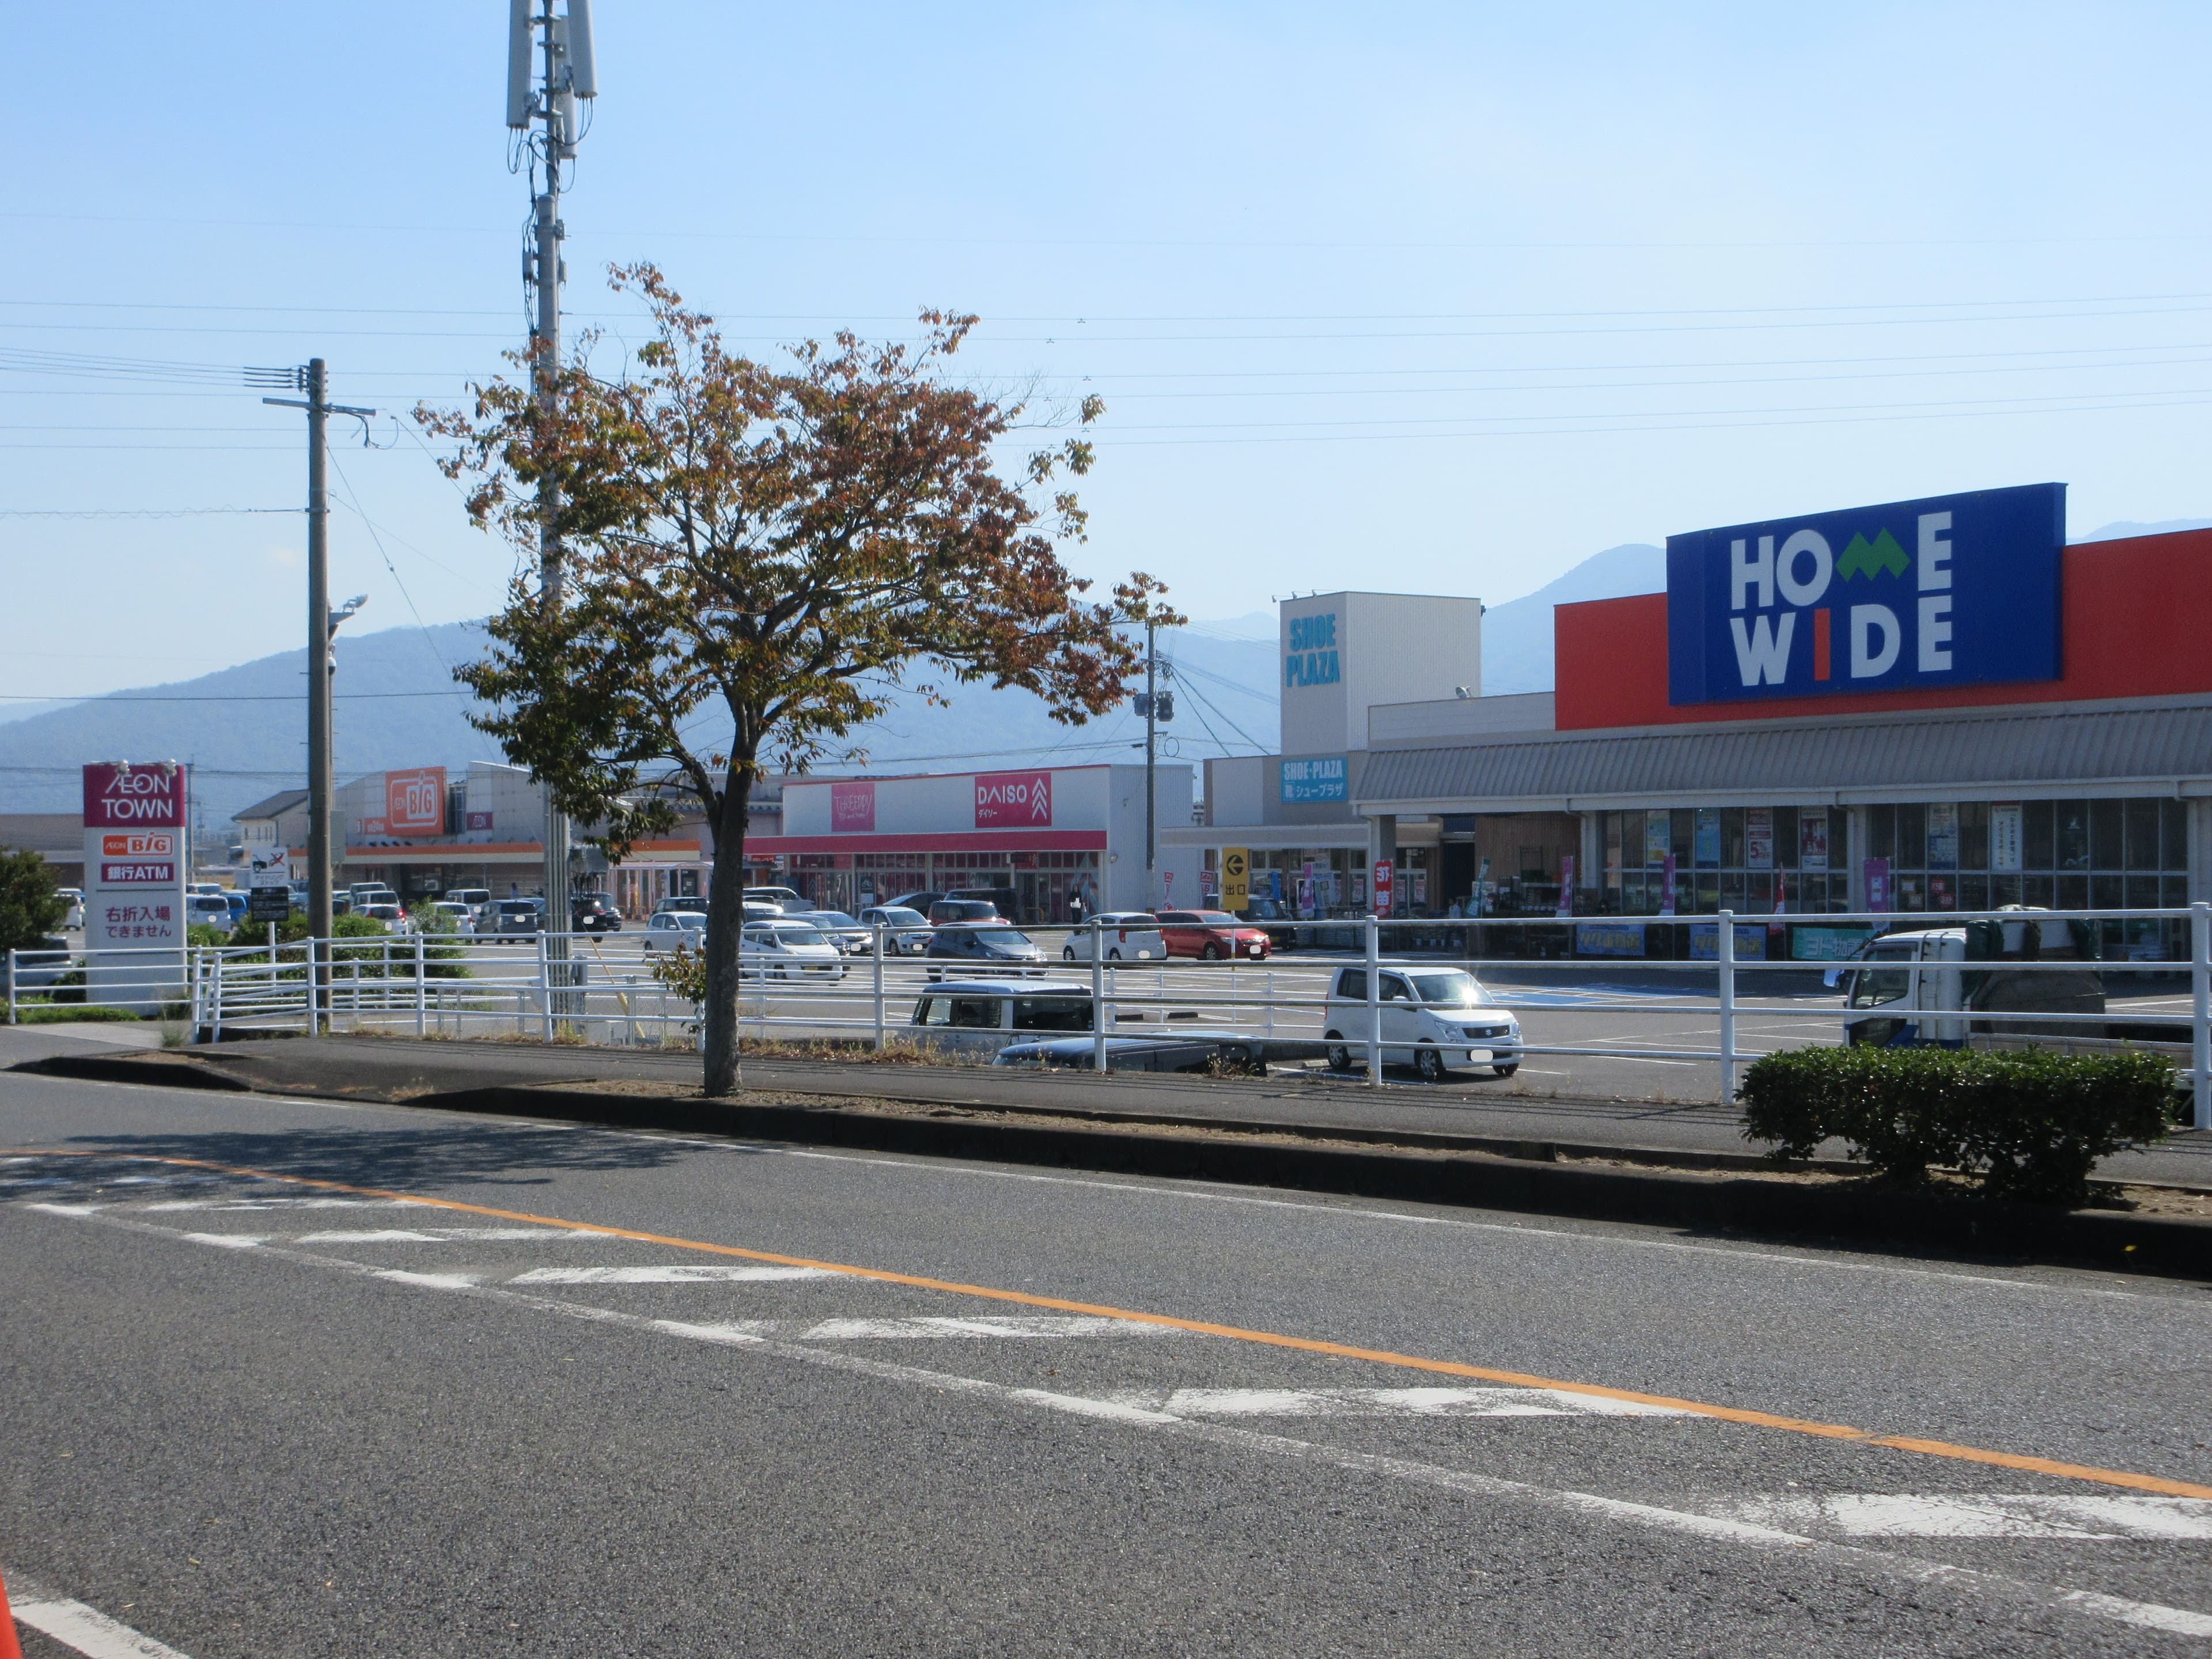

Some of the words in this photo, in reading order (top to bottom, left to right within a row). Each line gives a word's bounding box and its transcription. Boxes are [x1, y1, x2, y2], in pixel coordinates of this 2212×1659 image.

[1730, 511, 1952, 610] HOME
[1290, 613, 1336, 652] SHOE
[1729, 595, 1952, 687] WIDE
[1286, 650, 1340, 688] PLAZA
[978, 785, 1027, 805] DAISO
[1296, 782, 1344, 797] シュープラザ
[101, 798, 172, 819] TOWN
[108, 866, 168, 880] 銀行ATM
[1226, 884, 1245, 895] 出口
[105, 906, 171, 922] 右折入場
[105, 925, 172, 938] できません
